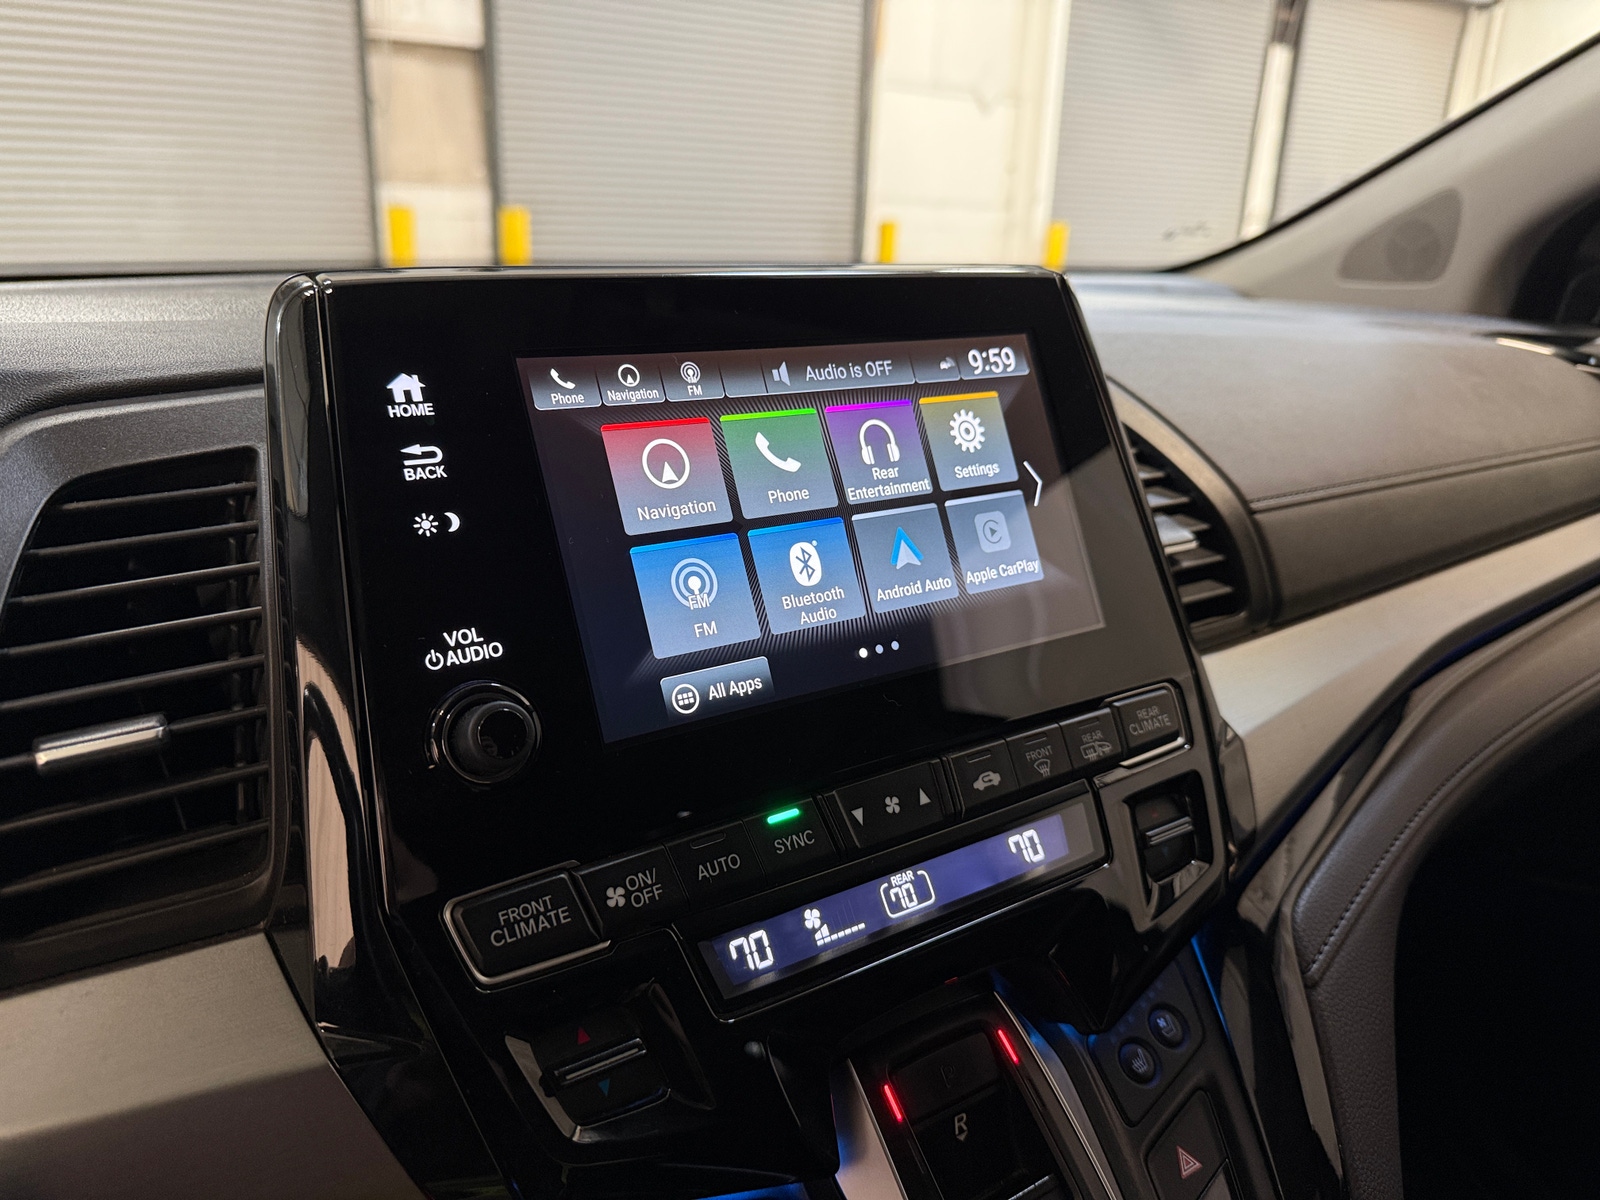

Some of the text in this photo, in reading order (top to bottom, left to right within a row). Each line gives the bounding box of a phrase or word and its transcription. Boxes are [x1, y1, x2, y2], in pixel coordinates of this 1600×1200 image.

[805, 360, 893, 382] Audio is OFF
[967, 347, 1017, 374] 9:59
[550, 391, 585, 405] Phone
[607, 387, 660, 403] Navigation
[687, 384, 703, 396] FM
[387, 402, 435, 418] HOME
[402, 465, 448, 481] BACK
[872, 467, 900, 480] Rear
[954, 462, 1000, 479] Settings
[767, 487, 810, 504] Phone
[847, 477, 931, 501] Entertainment
[637, 499, 717, 522] Navigation
[966, 559, 1040, 586] Apple CarPlay
[781, 586, 845, 610] Bluetooth
[876, 576, 953, 602] Android Auto
[800, 607, 838, 626] Audio
[443, 627, 484, 647] VOL
[694, 620, 718, 638] FM
[446, 641, 503, 667] AUDIO
[708, 676, 763, 701] All Apps
[1129, 713, 1172, 736] CLIMATE
[1136, 705, 1160, 721] REAR
[1081, 729, 1104, 744] REAR
[1025, 745, 1054, 762] FRONT
[773, 829, 815, 854] SYNC
[1007, 829, 1045, 864] 70
[697, 853, 741, 881] AUTO
[890, 870, 914, 887] REAR
[625, 868, 657, 891] ON/
[630, 884, 664, 909] OFF
[890, 884, 918, 909] 70
[498, 895, 552, 926] FRONT
[490, 906, 572, 948] CLIMATE
[728, 929, 774, 971] 70
[954, 1112, 967, 1135] R
